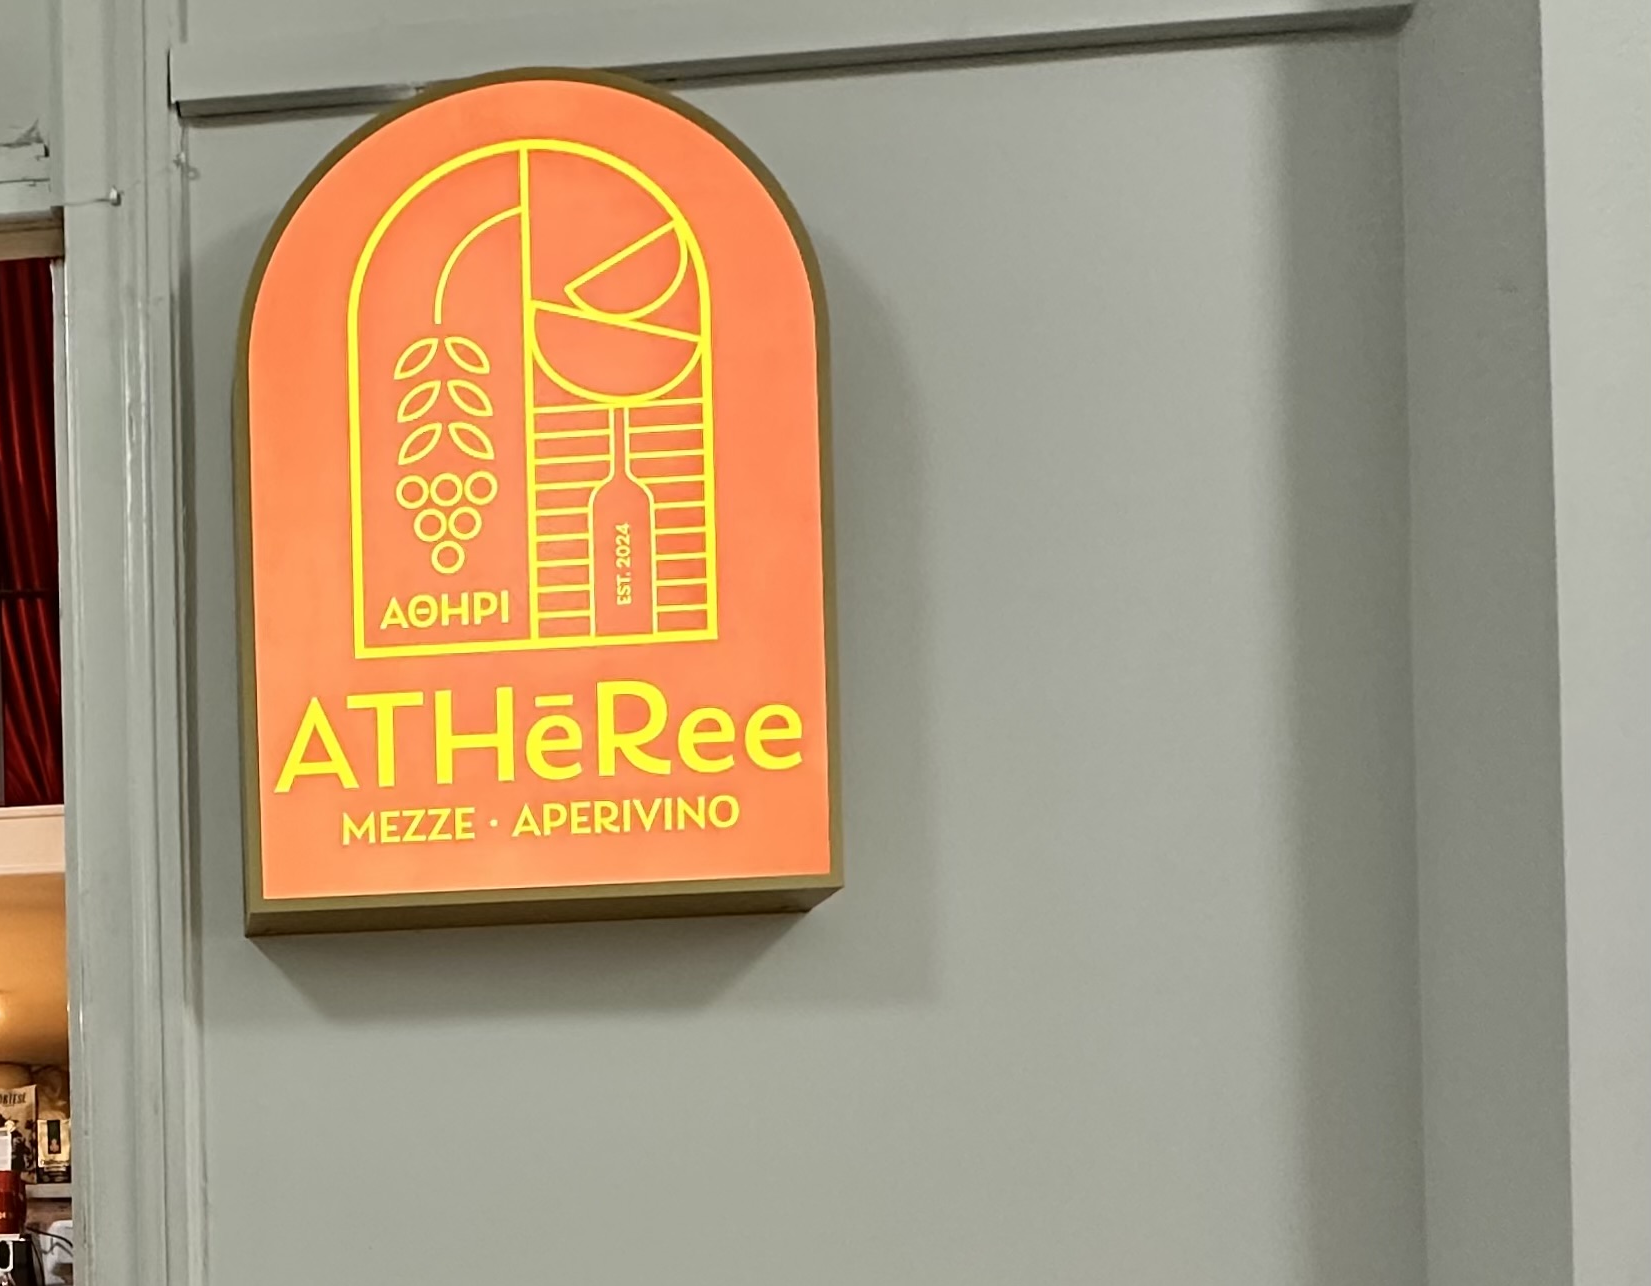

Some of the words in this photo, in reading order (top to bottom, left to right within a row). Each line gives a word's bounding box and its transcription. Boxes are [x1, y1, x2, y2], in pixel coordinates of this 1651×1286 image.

[614, 522, 631, 569] 2024
[380, 590, 510, 629] ΑΘΗΡΙ
[616, 571, 632, 606] EST.
[274, 680, 804, 794] ATHēRee
[342, 806, 475, 845] MEZZE
[511, 794, 741, 838] APERIVINO
